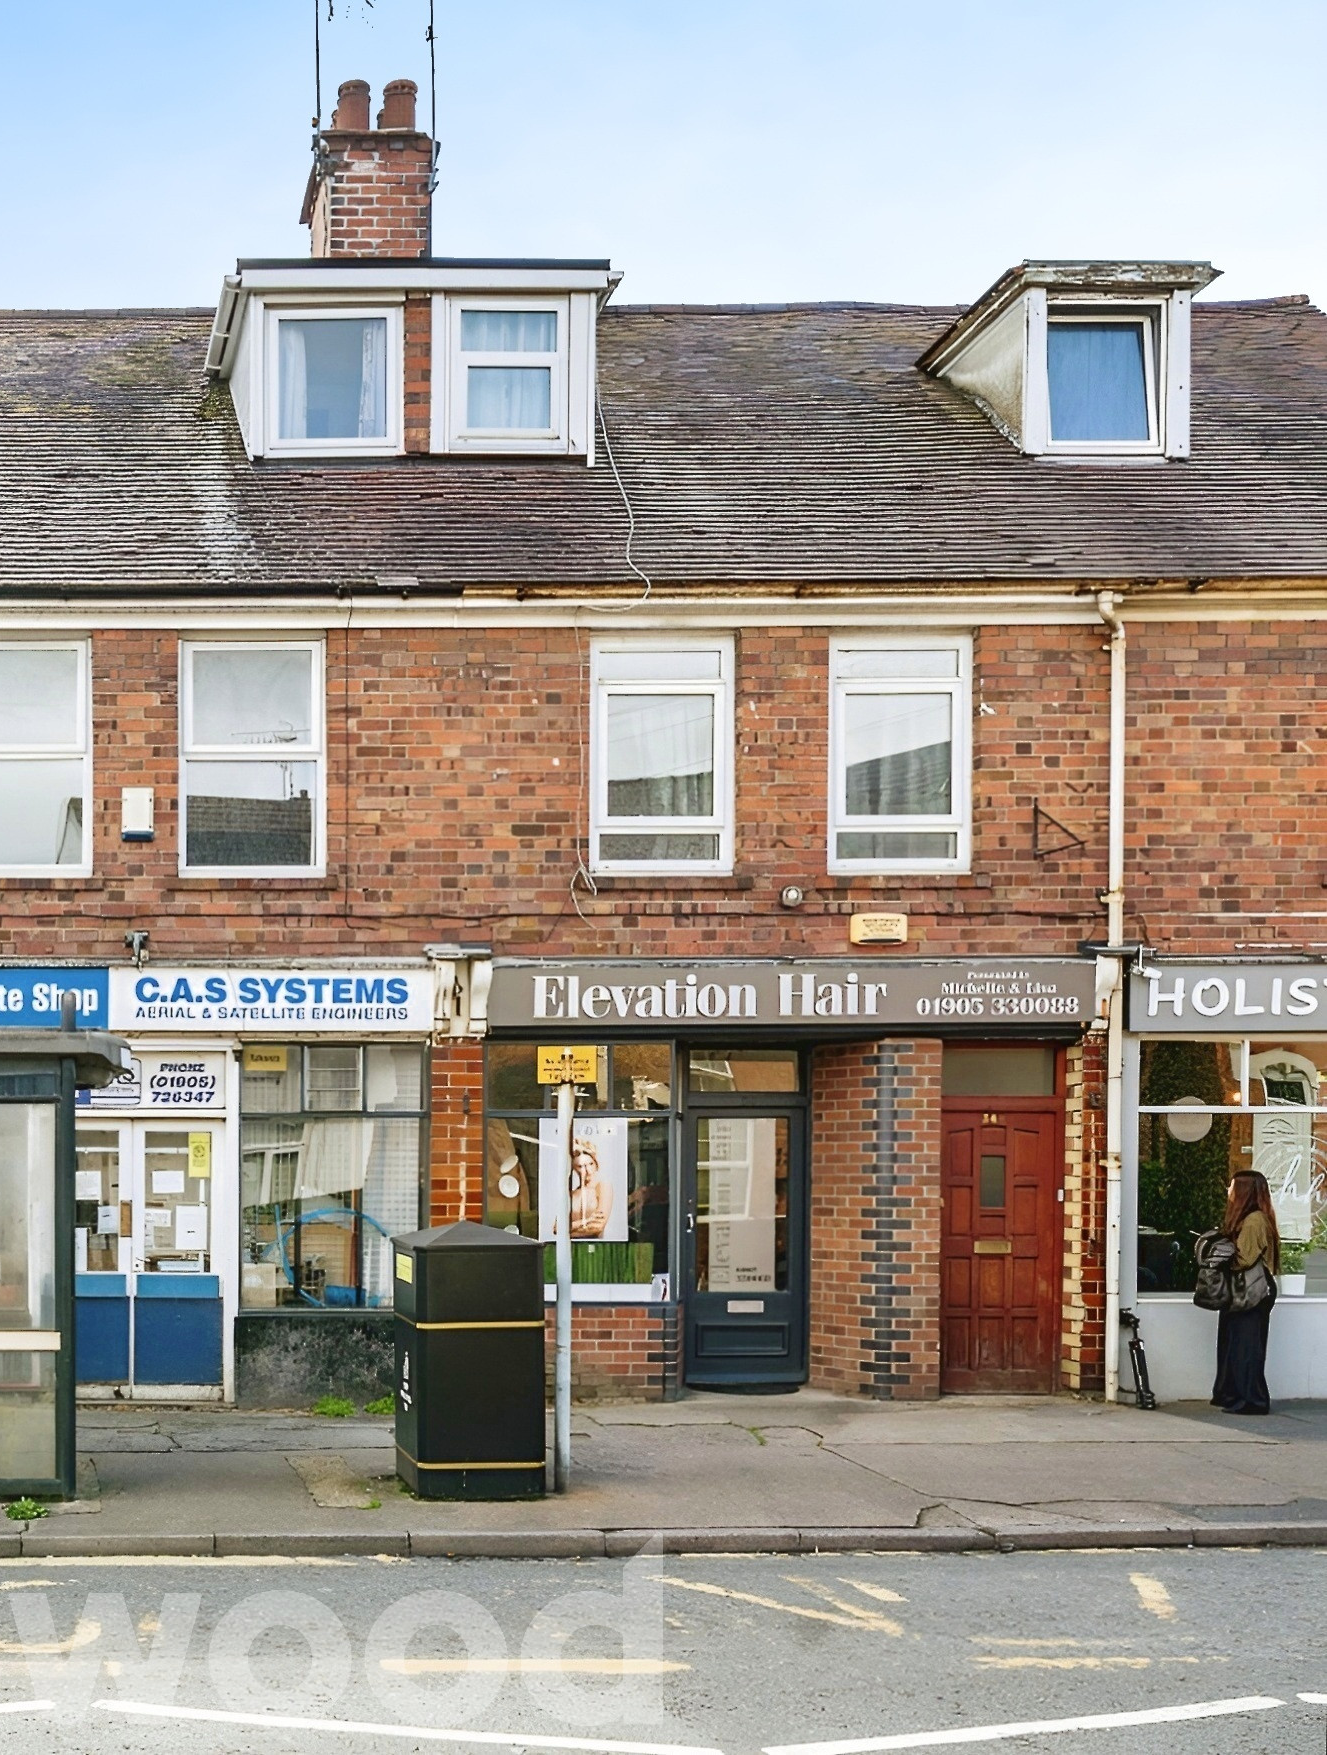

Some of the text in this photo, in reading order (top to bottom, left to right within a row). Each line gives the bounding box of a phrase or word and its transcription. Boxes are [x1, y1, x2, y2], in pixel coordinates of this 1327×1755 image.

[135, 977, 409, 1005] C.A.S SYSTEMS
[533, 972, 888, 1018] Elevation Hair
[1147, 978, 1327, 1017] HOLIS
[136, 1007, 409, 1020] AERIAL & SATELLITE ENGINEERS
[916, 997, 985, 1016] 01905
